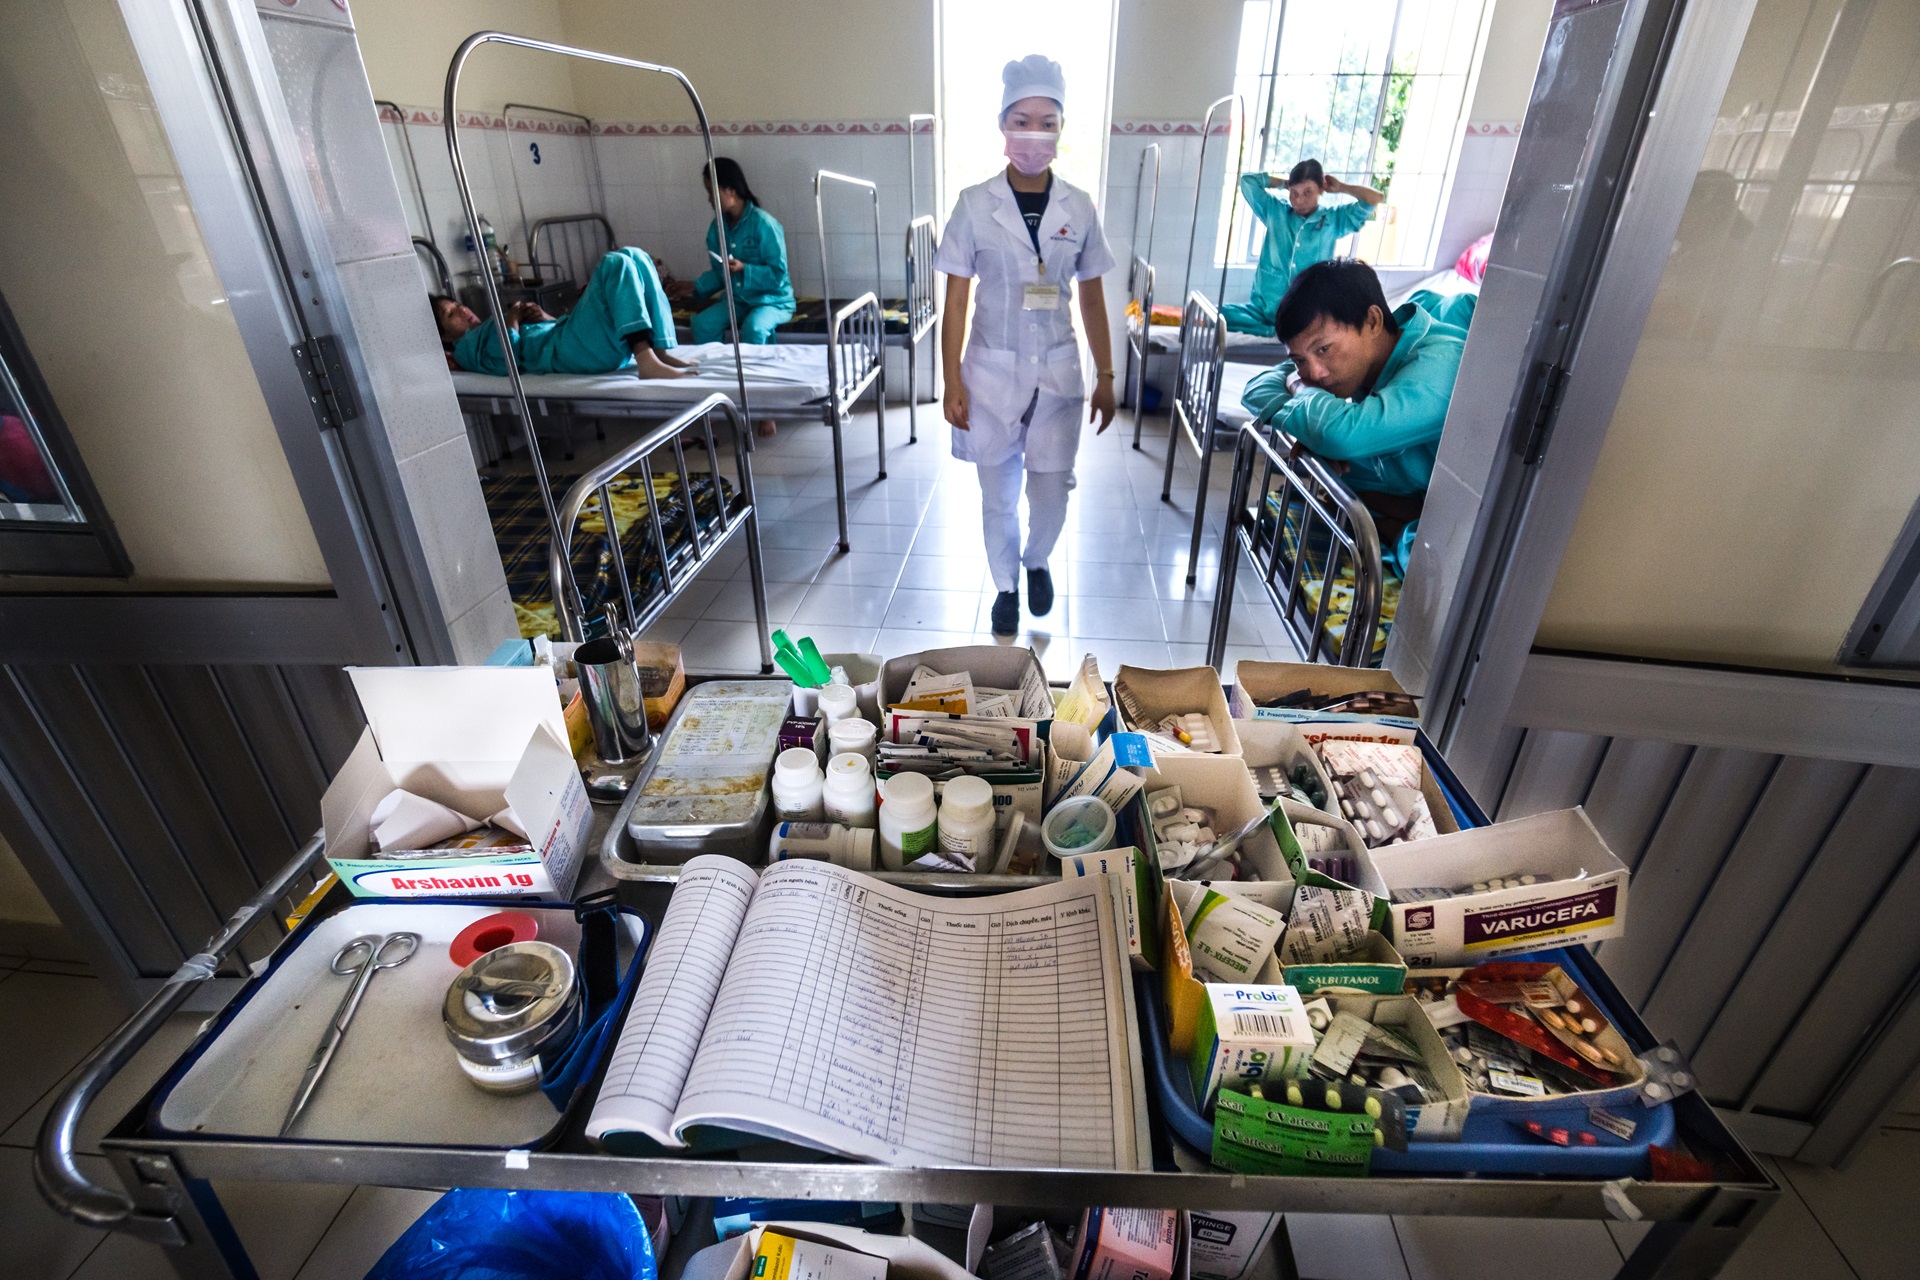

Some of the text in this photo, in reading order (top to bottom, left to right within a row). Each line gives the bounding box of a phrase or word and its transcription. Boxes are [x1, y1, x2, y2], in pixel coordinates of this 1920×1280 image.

[530, 142, 541, 165] 3
[391, 873, 534, 890] Arshavin 1g
[1481, 903, 1598, 935] VARUCEFA
[1309, 912, 1323, 943] Hesmin
[1410, 956, 1432, 966] 2g
[1308, 976, 1380, 984] SALBUTAMOL
[1236, 990, 1287, 1001] Probio
[1239, 1051, 1267, 1078] bio
[1266, 1111, 1329, 1129] CV artecan
[1243, 1136, 1284, 1152] artecan
[1328, 1153, 1364, 1163] artecan
[1192, 1217, 1233, 1231] YRINGE
